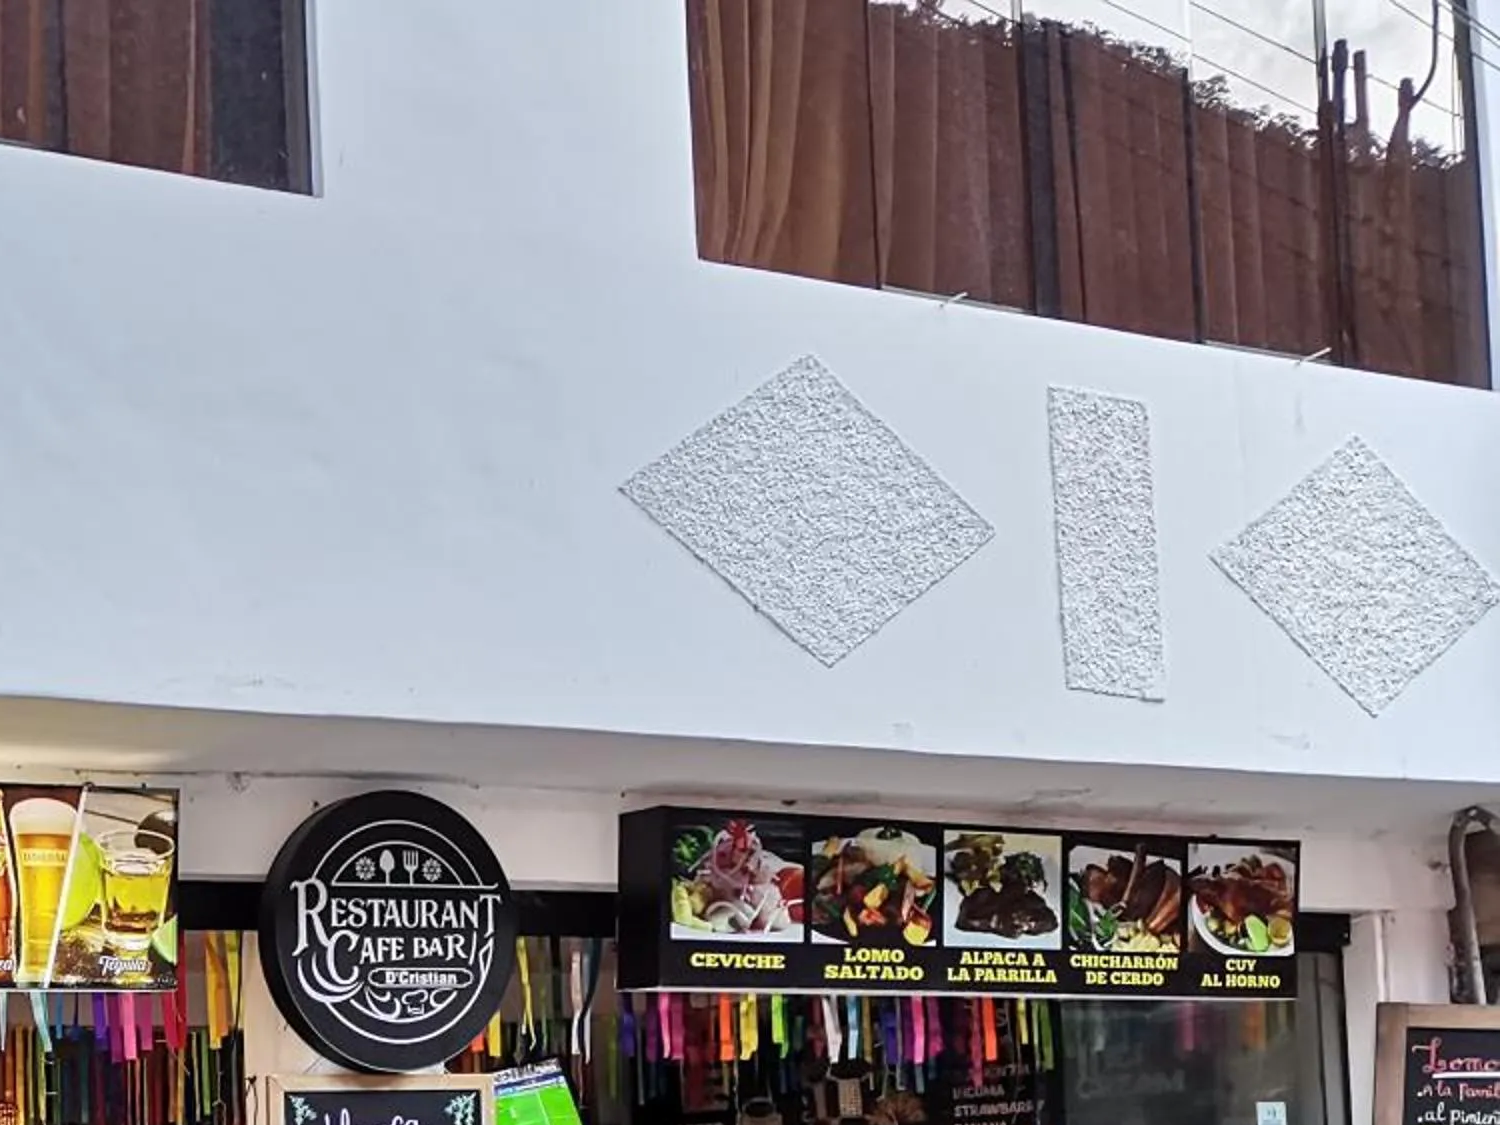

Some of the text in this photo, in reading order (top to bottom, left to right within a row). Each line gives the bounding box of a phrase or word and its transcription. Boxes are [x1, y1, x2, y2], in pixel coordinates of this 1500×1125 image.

[290, 878, 502, 957] RESTAURANT
[327, 930, 468, 985] CAFE BAR
[690, 952, 785, 969] CEVICHE
[844, 948, 905, 963] LOMO
[960, 951, 1046, 967] ALPACA A
[1070, 953, 1179, 971] CHICHARRÓN
[99, 955, 150, 976] Tequila
[824, 965, 924, 981] SALTADO
[1225, 958, 1257, 972] CUY
[947, 967, 1057, 983] LA PARRILLA
[1085, 971, 1164, 986] DE CERDO
[1201, 973, 1281, 988] AL HORNO
[1425, 1101, 1447, 1122] al
